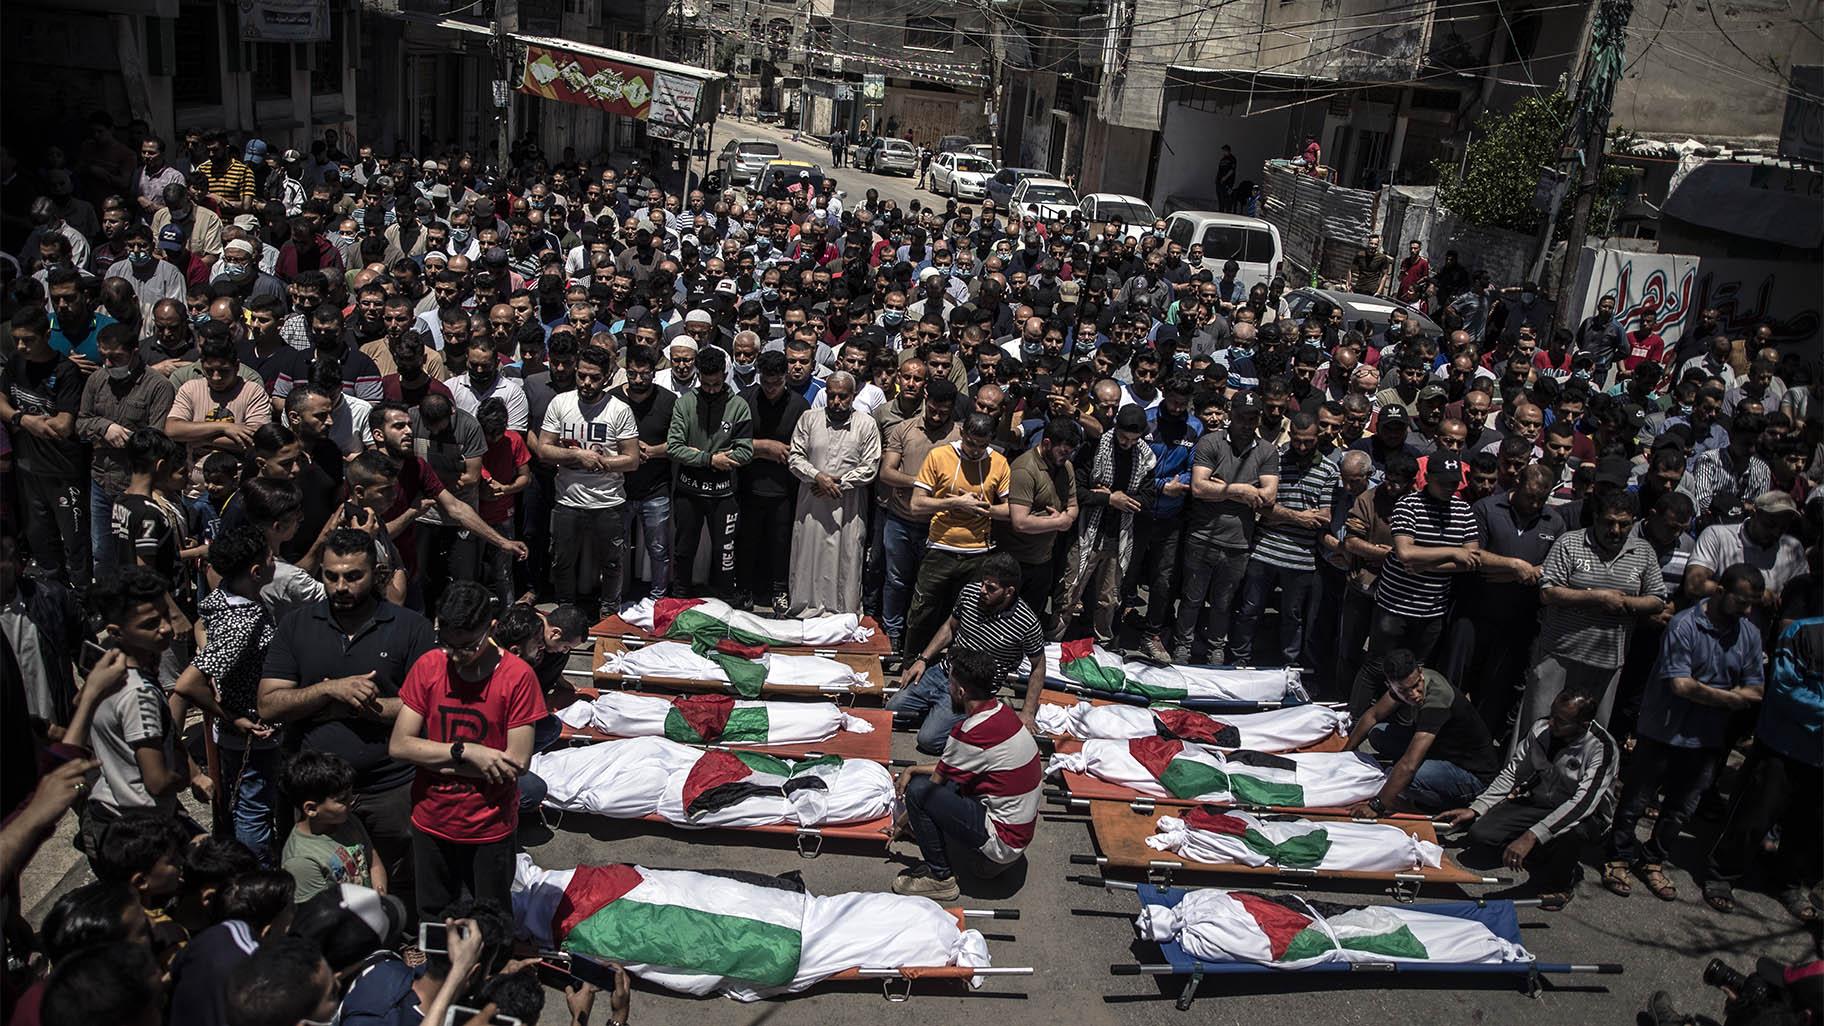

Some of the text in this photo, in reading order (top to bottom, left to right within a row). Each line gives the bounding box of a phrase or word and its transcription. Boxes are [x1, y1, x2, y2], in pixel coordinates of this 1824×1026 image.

[563, 422, 605, 442] HIL
[679, 472, 699, 488] IDEA
[142, 519, 156, 538] 7
[721, 539, 735, 572] IDEA
[1575, 558, 1591, 572] 25
